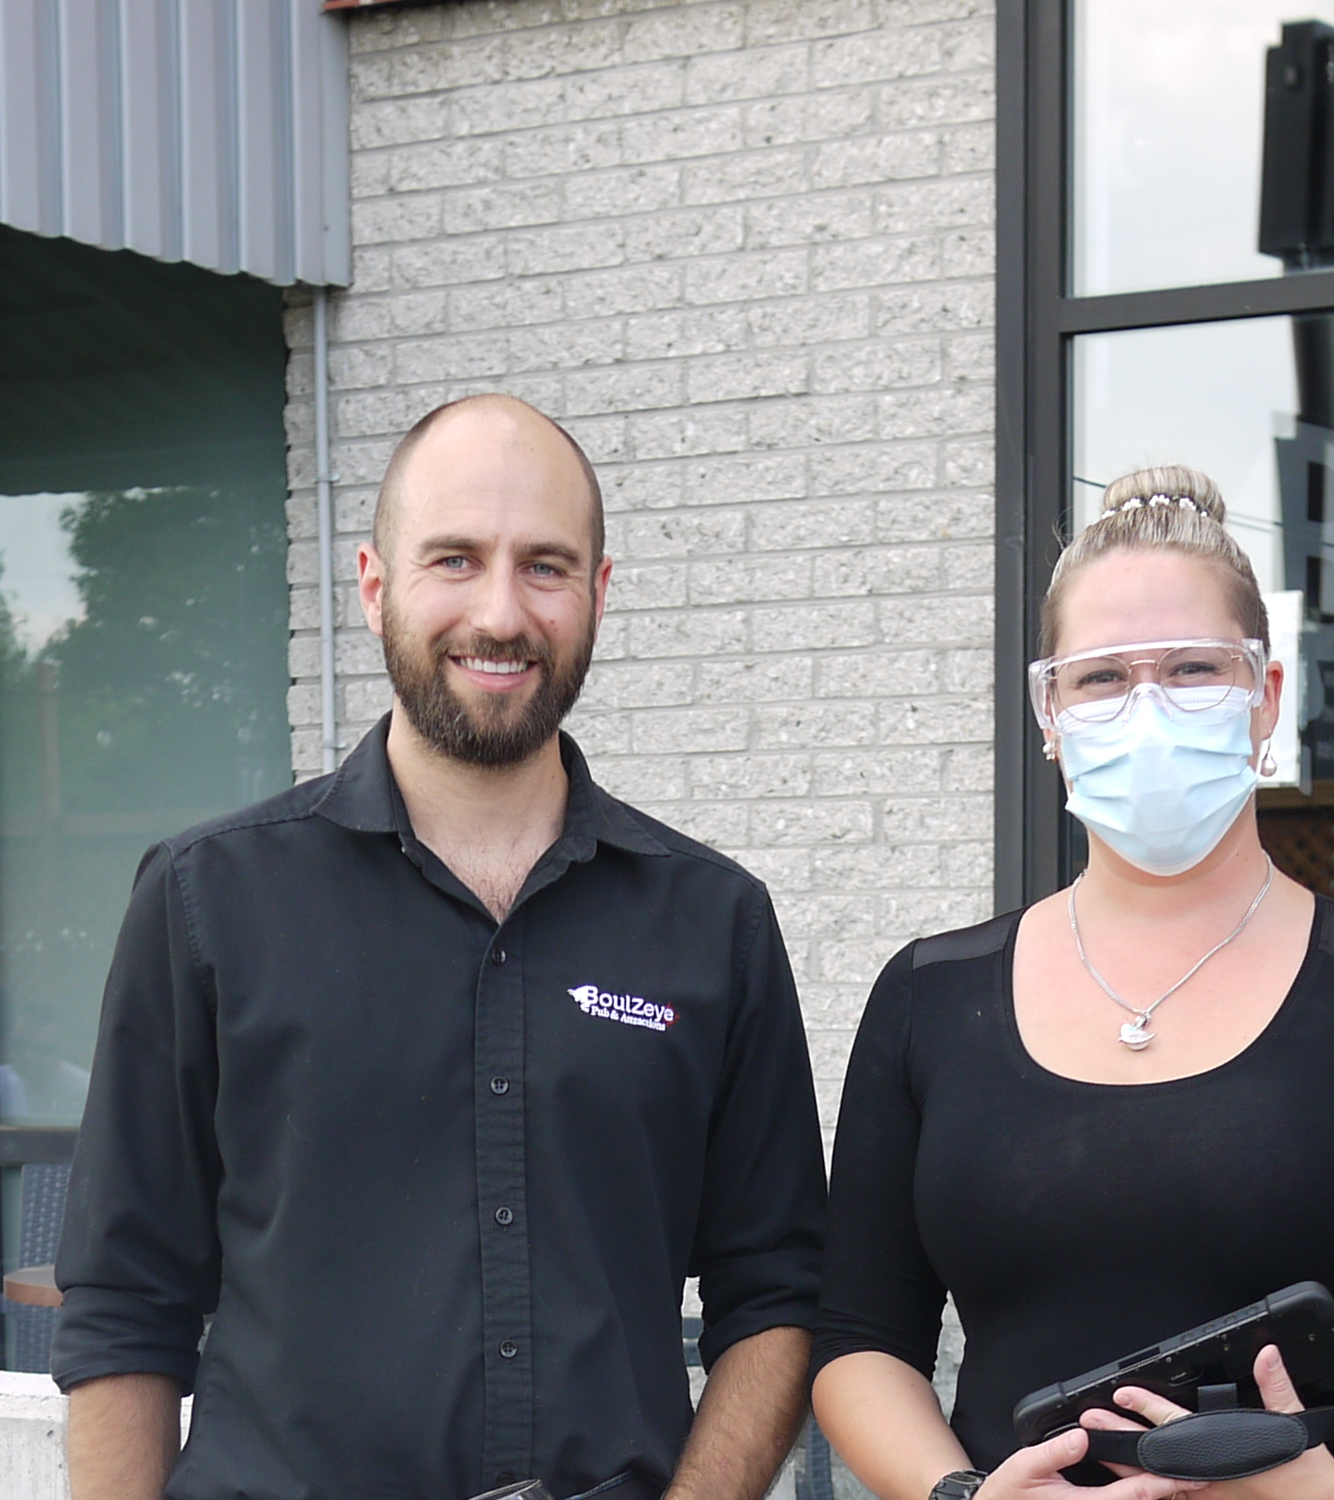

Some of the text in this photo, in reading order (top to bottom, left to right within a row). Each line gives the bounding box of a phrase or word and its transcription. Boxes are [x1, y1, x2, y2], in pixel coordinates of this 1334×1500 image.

[578, 985, 674, 1022] BoulZeye
[591, 1005, 610, 1018] Pub
[610, 1010, 620, 1021] &
